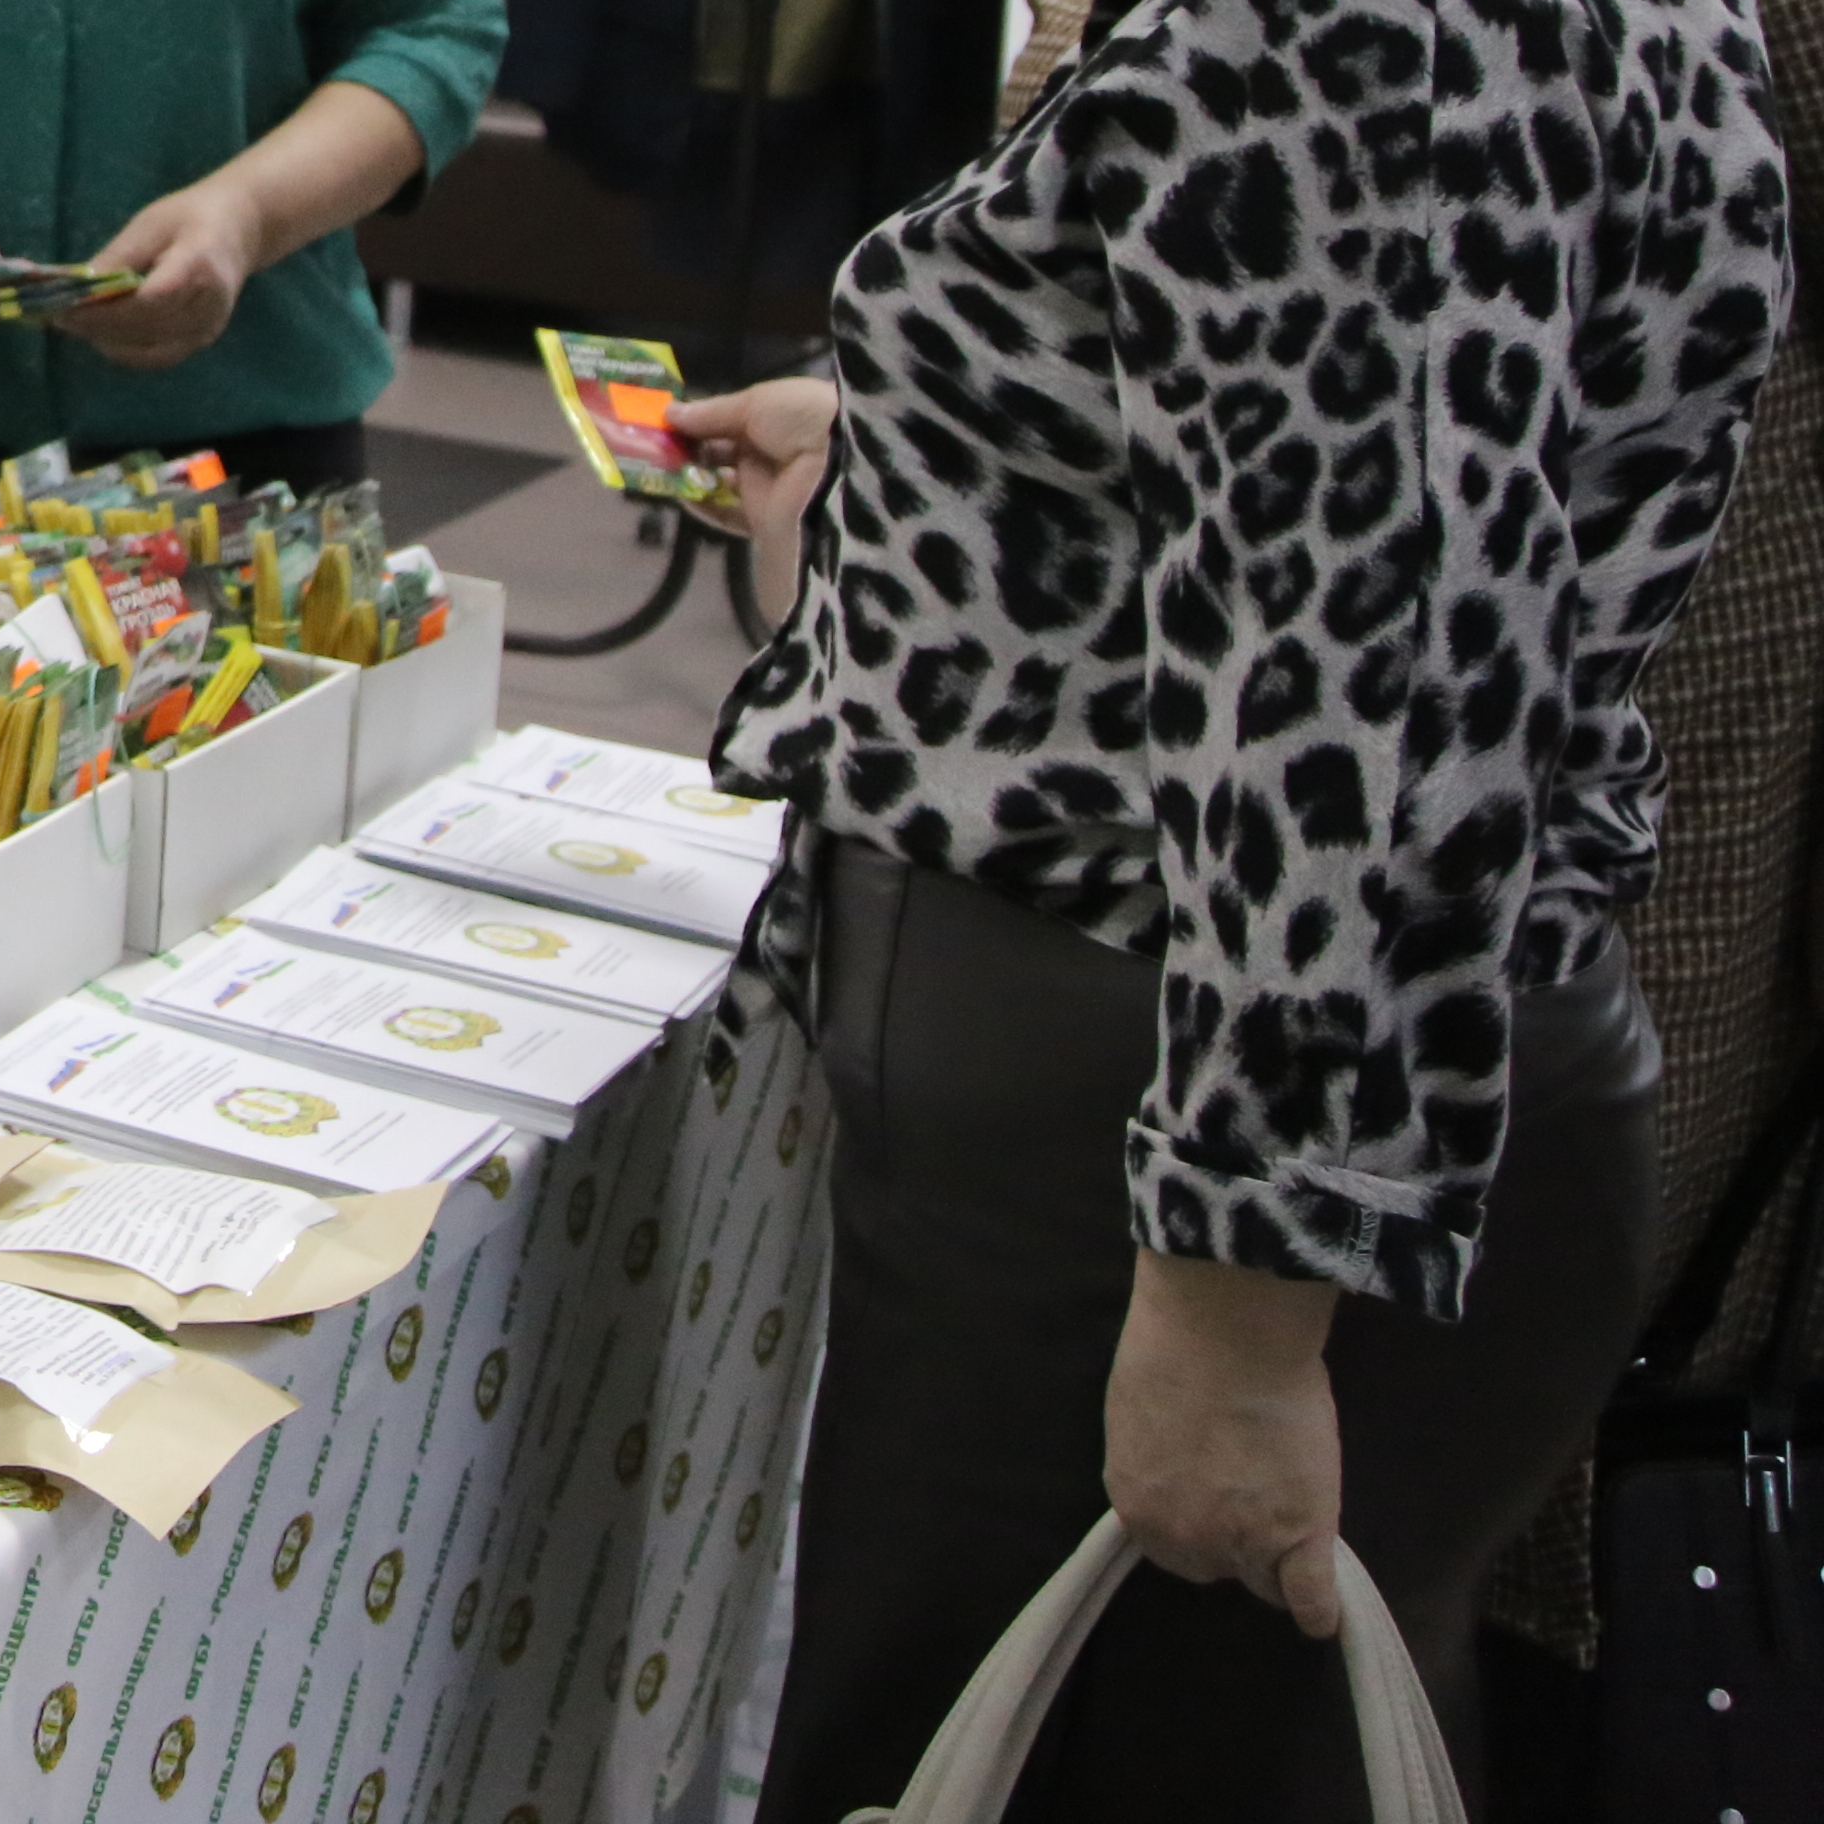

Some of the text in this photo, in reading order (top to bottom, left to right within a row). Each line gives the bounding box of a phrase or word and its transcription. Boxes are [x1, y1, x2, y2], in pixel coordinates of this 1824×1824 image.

[308, 1434, 332, 1498] ФГБУ
[67, 1597, 100, 1667] ФГБУ
[184, 1633, 212, 1701] ФГБУ
[289, 1665, 313, 1729] ФГБУ
[83, 1596, 167, 1824] ОССЕЛЬХОЗЦЕНТР»
